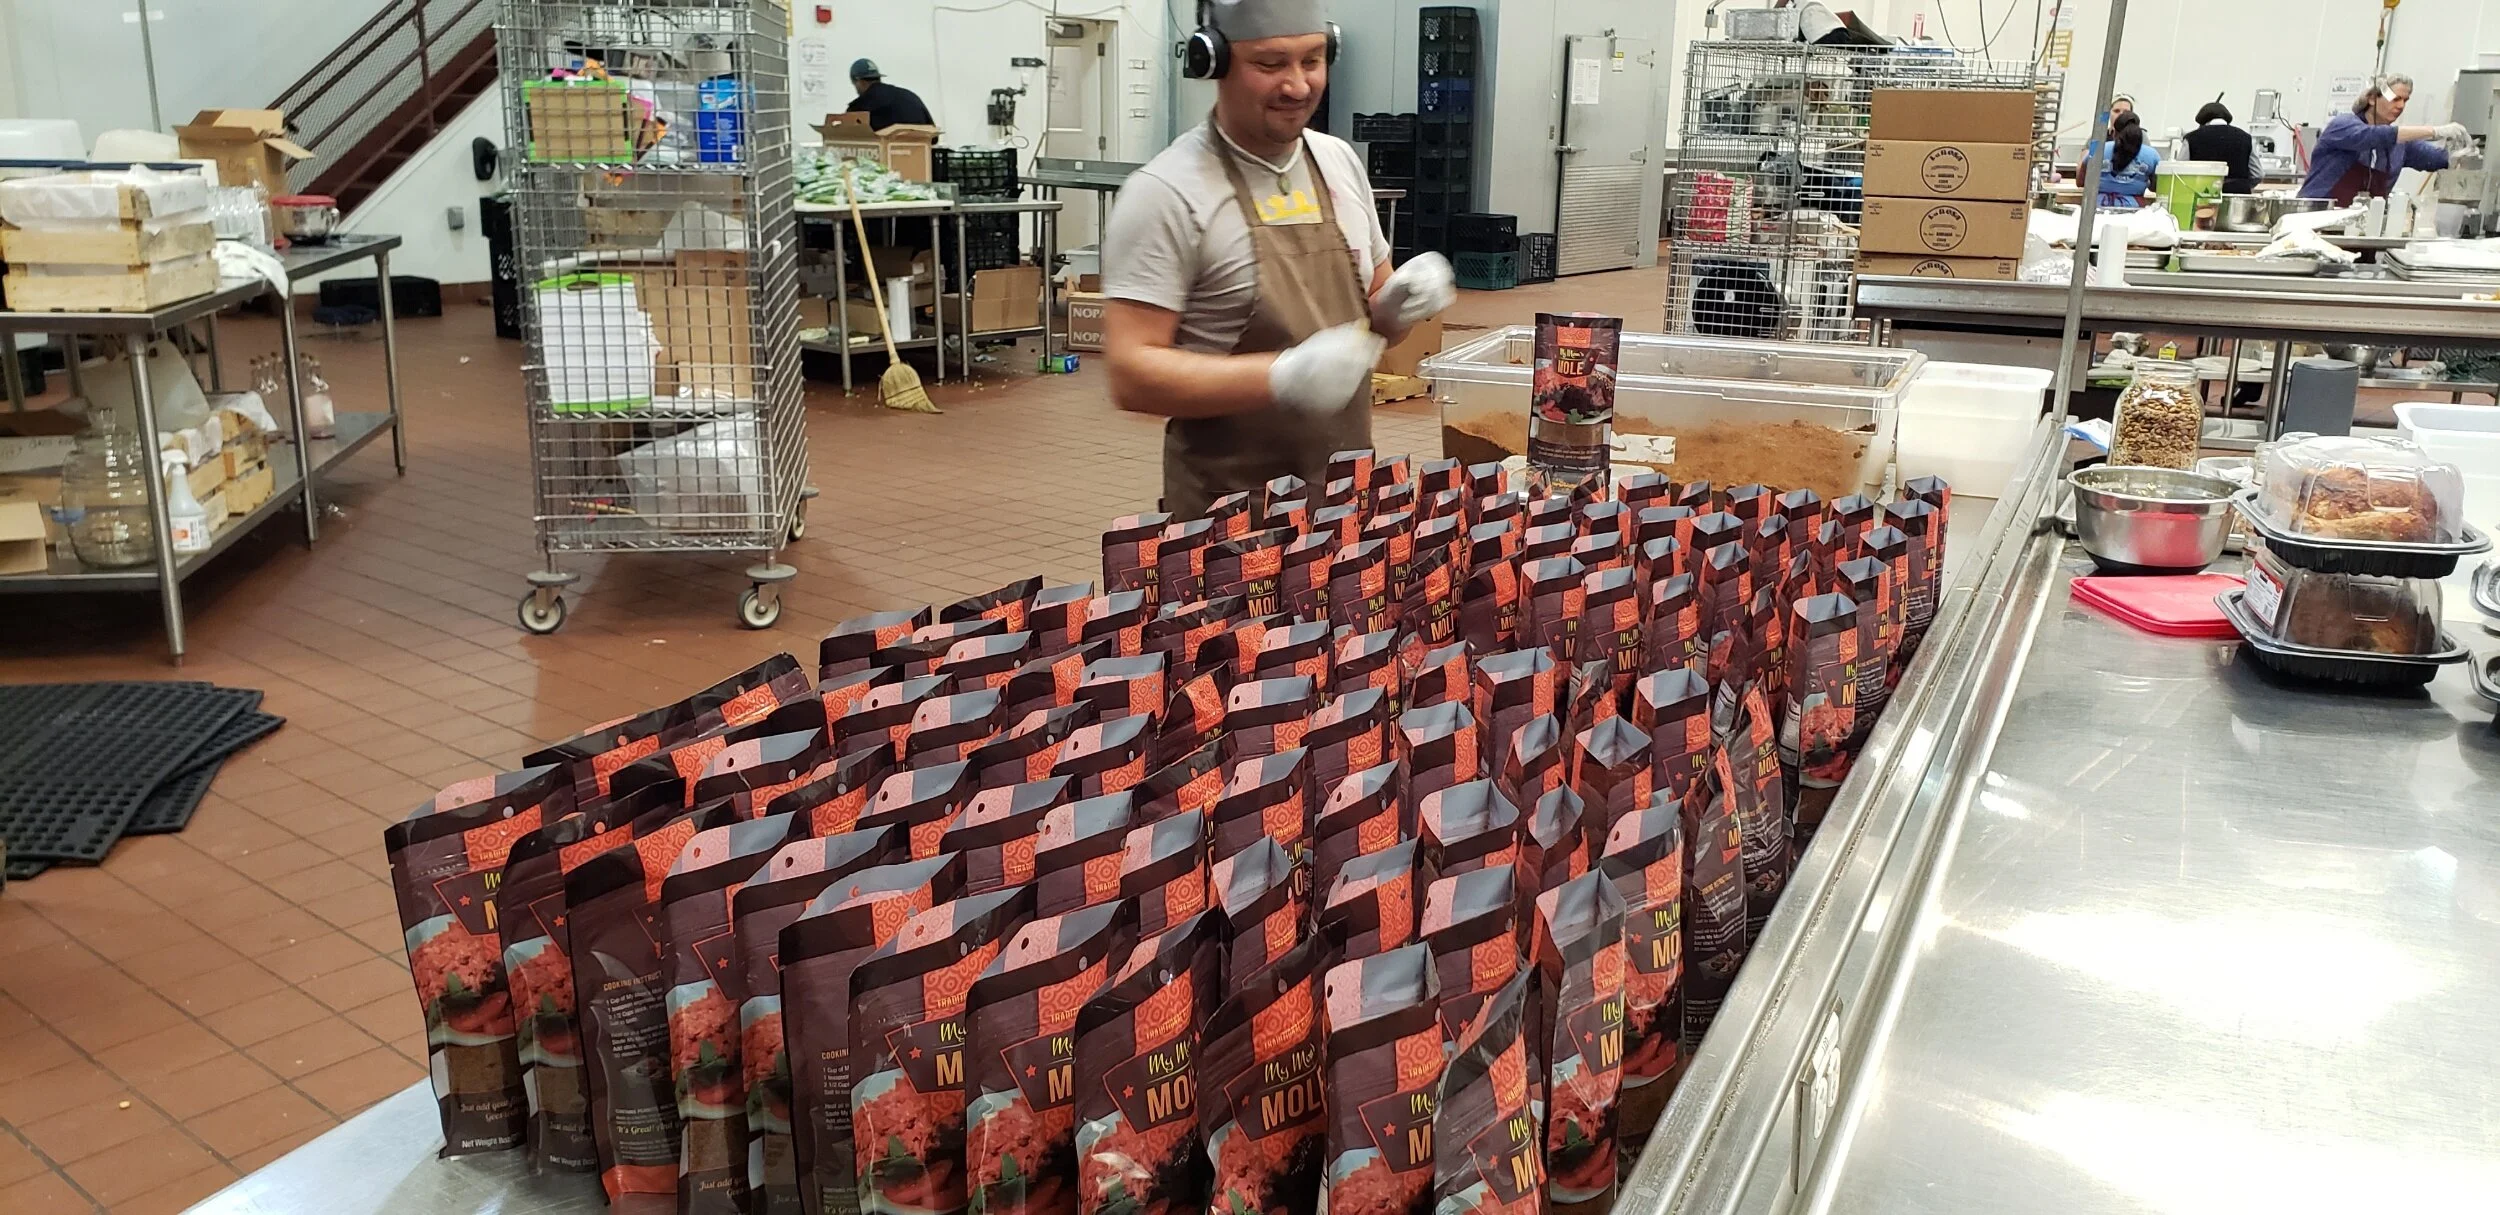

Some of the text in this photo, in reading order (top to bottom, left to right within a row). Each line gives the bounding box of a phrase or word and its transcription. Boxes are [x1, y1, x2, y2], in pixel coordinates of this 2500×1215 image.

[1557, 359, 1584, 376] MOLE
[1149, 1052, 1174, 1075] My
[1264, 1060, 1290, 1083] My
[461, 1138, 474, 1149] Net
